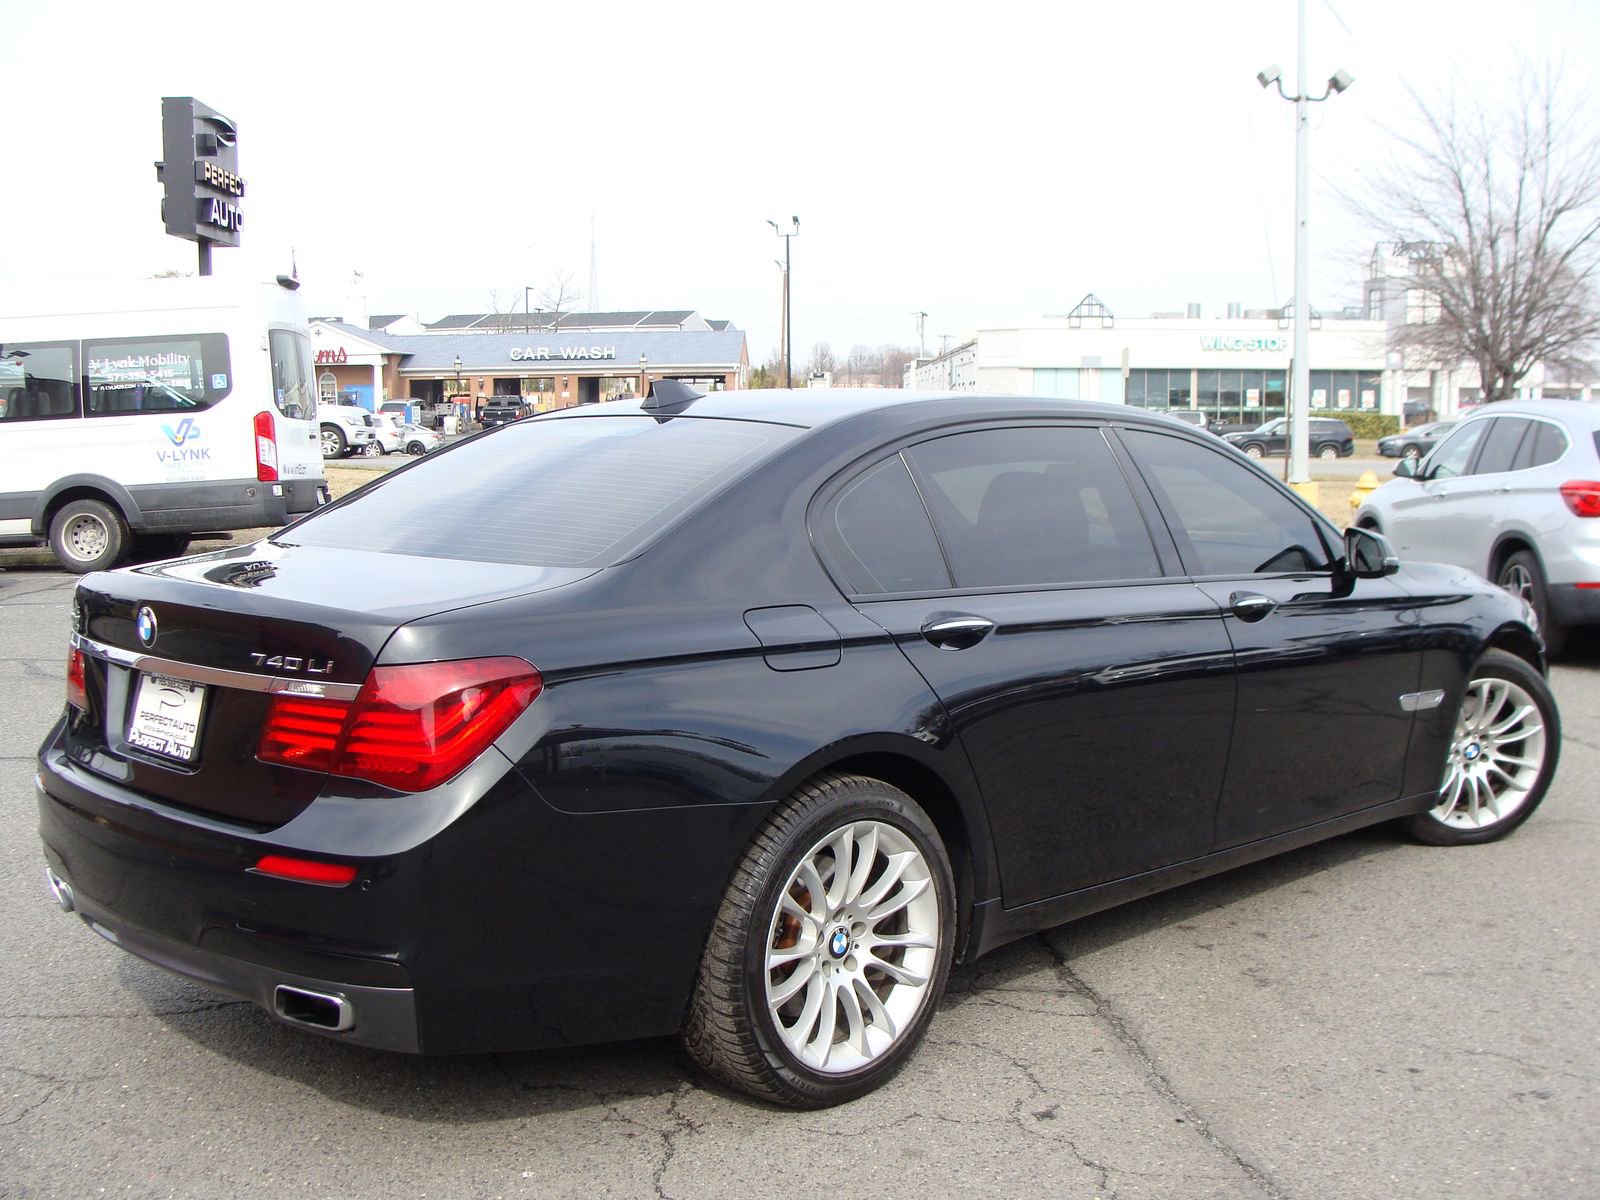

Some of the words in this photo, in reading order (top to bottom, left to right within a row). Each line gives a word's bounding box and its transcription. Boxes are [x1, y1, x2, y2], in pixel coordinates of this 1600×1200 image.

[204, 160, 247, 196] PERFECT
[211, 198, 244, 232] AUTO
[140, 352, 190, 367] Mobility
[510, 347, 550, 361] CAR
[560, 346, 616, 360] WASH
[156, 447, 211, 462] V-LYNK
[251, 652, 303, 671] 740
[307, 659, 334, 674] Li
